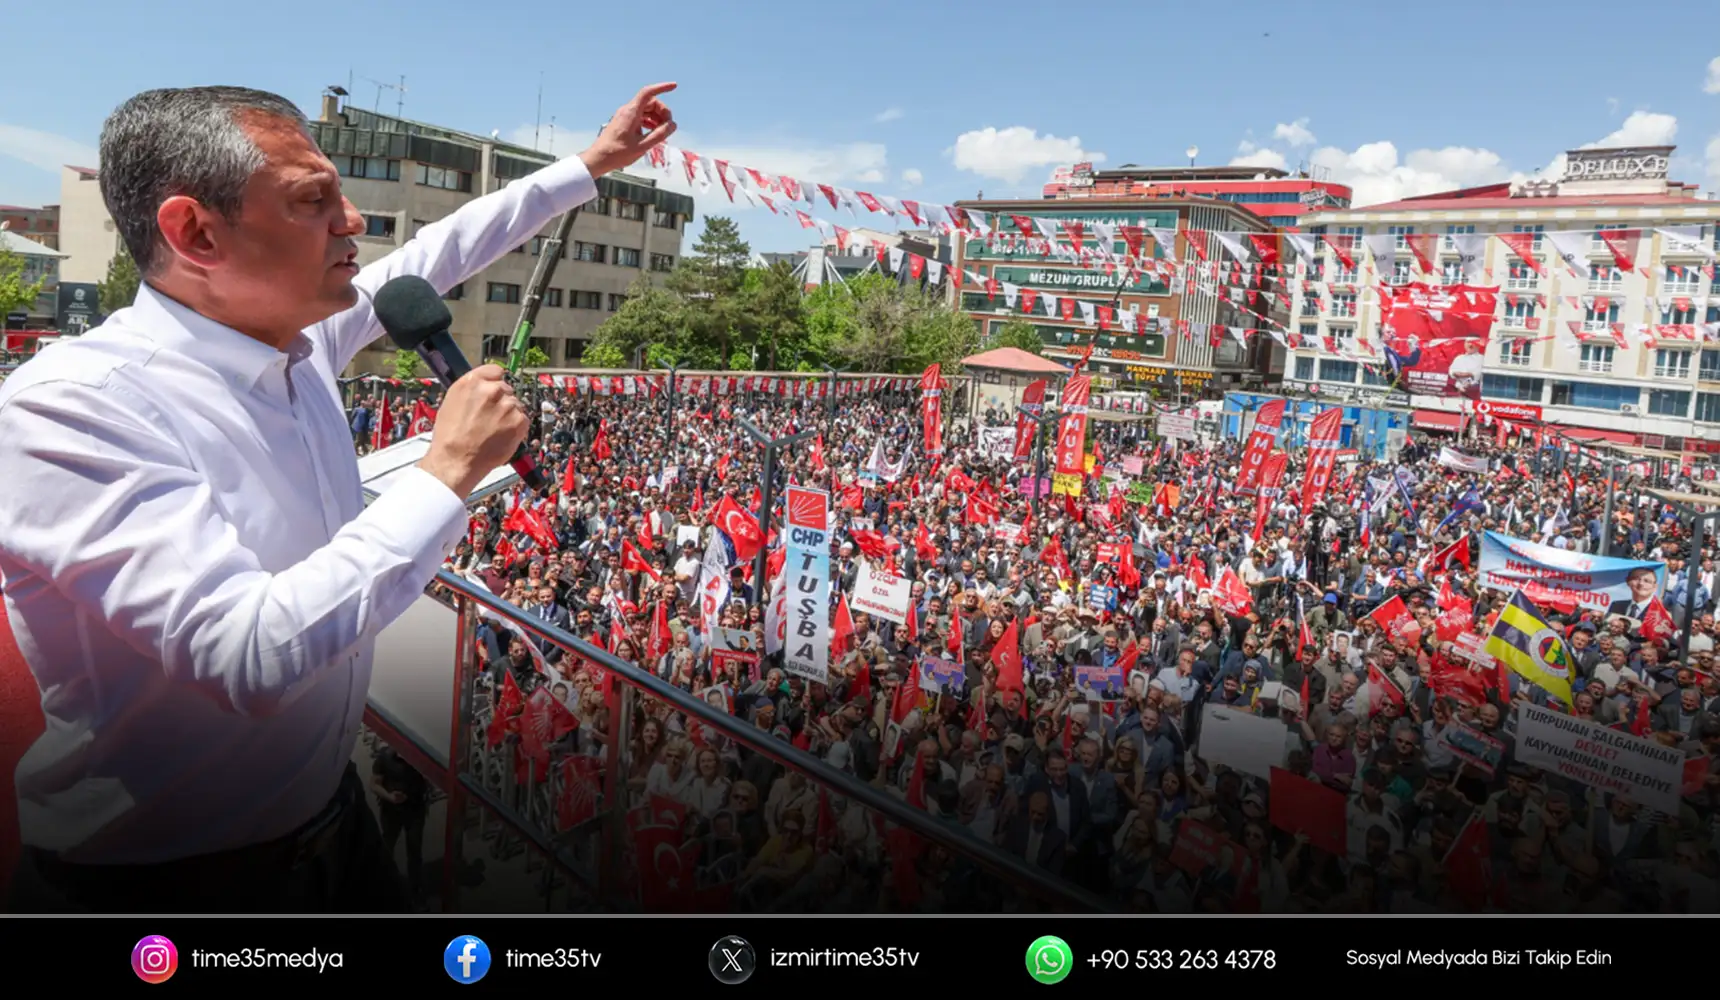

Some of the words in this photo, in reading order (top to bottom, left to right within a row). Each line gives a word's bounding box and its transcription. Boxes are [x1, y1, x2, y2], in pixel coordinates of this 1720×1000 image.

[1567, 154, 1668, 176] DELUXE
[1029, 272, 1070, 285] MEZUN
[1491, 402, 1537, 416] vodafone
[791, 528, 824, 548] CHP
[1505, 558, 1538, 578] HALK
[794, 552, 818, 662] TUŞBA
[1525, 708, 1589, 737] TURPUNAN
[1574, 738, 1620, 761] DEVLET
[1525, 735, 1609, 772] KAYYUMUNAN
[1611, 764, 1674, 795] BELEDİYE
